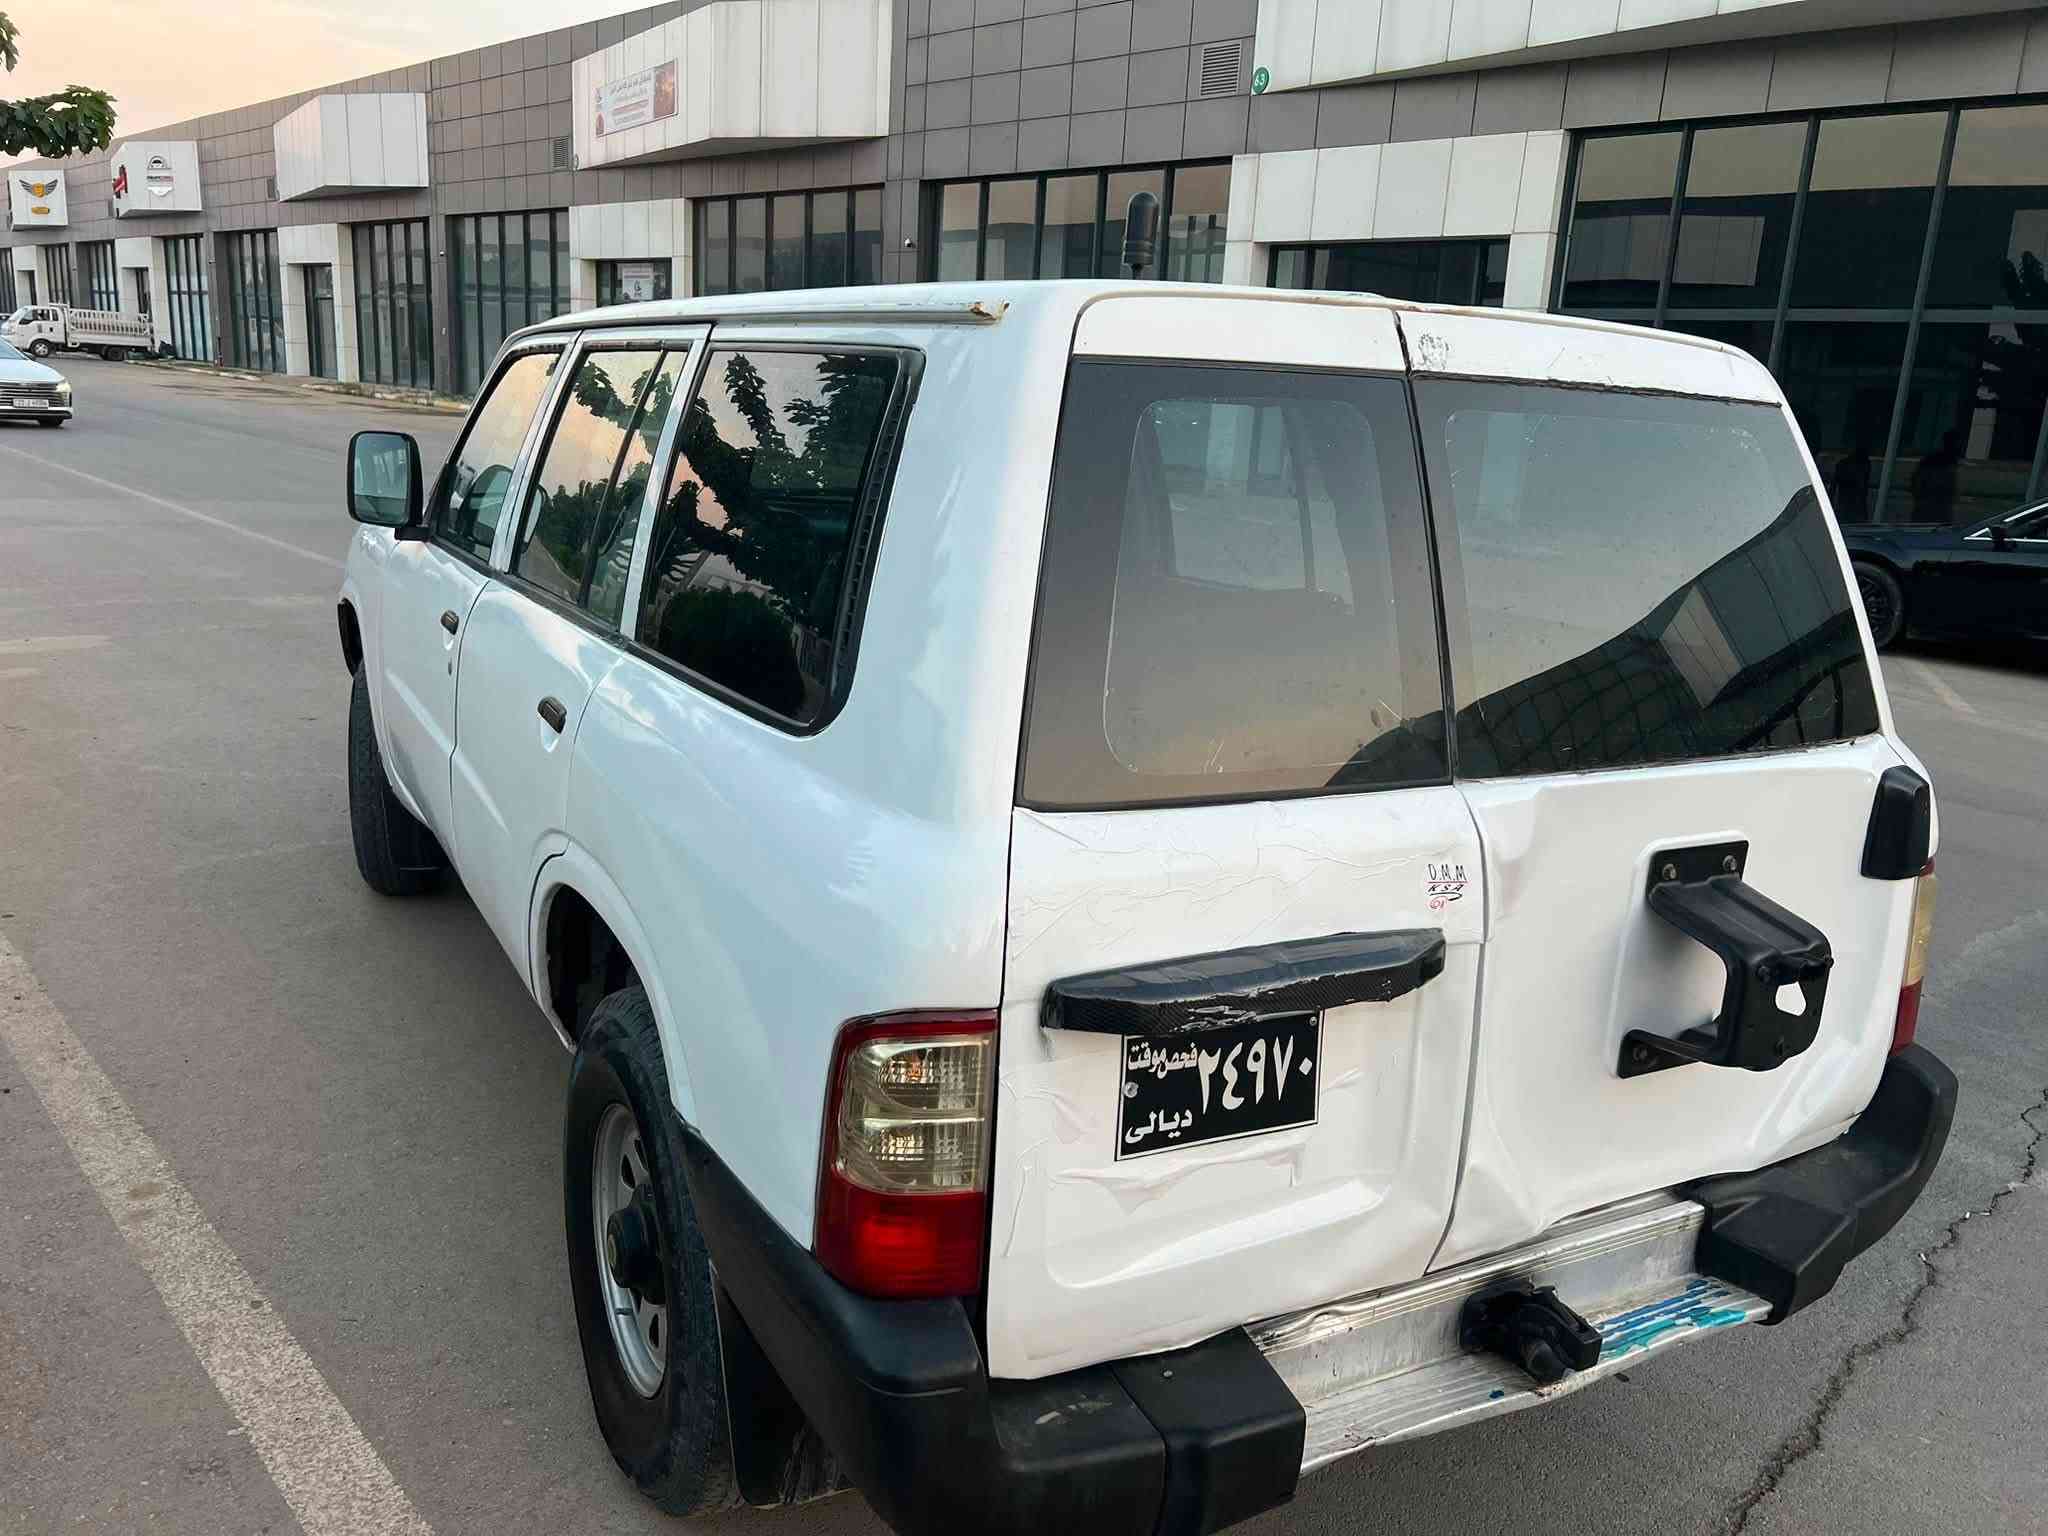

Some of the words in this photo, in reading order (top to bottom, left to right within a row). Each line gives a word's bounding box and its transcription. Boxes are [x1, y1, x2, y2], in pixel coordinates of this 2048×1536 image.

[1128, 1042, 1167, 1073] موقت
[1157, 1042, 1198, 1079] فحص
[1198, 1034, 1313, 1115] ٢٤٩٧٠
